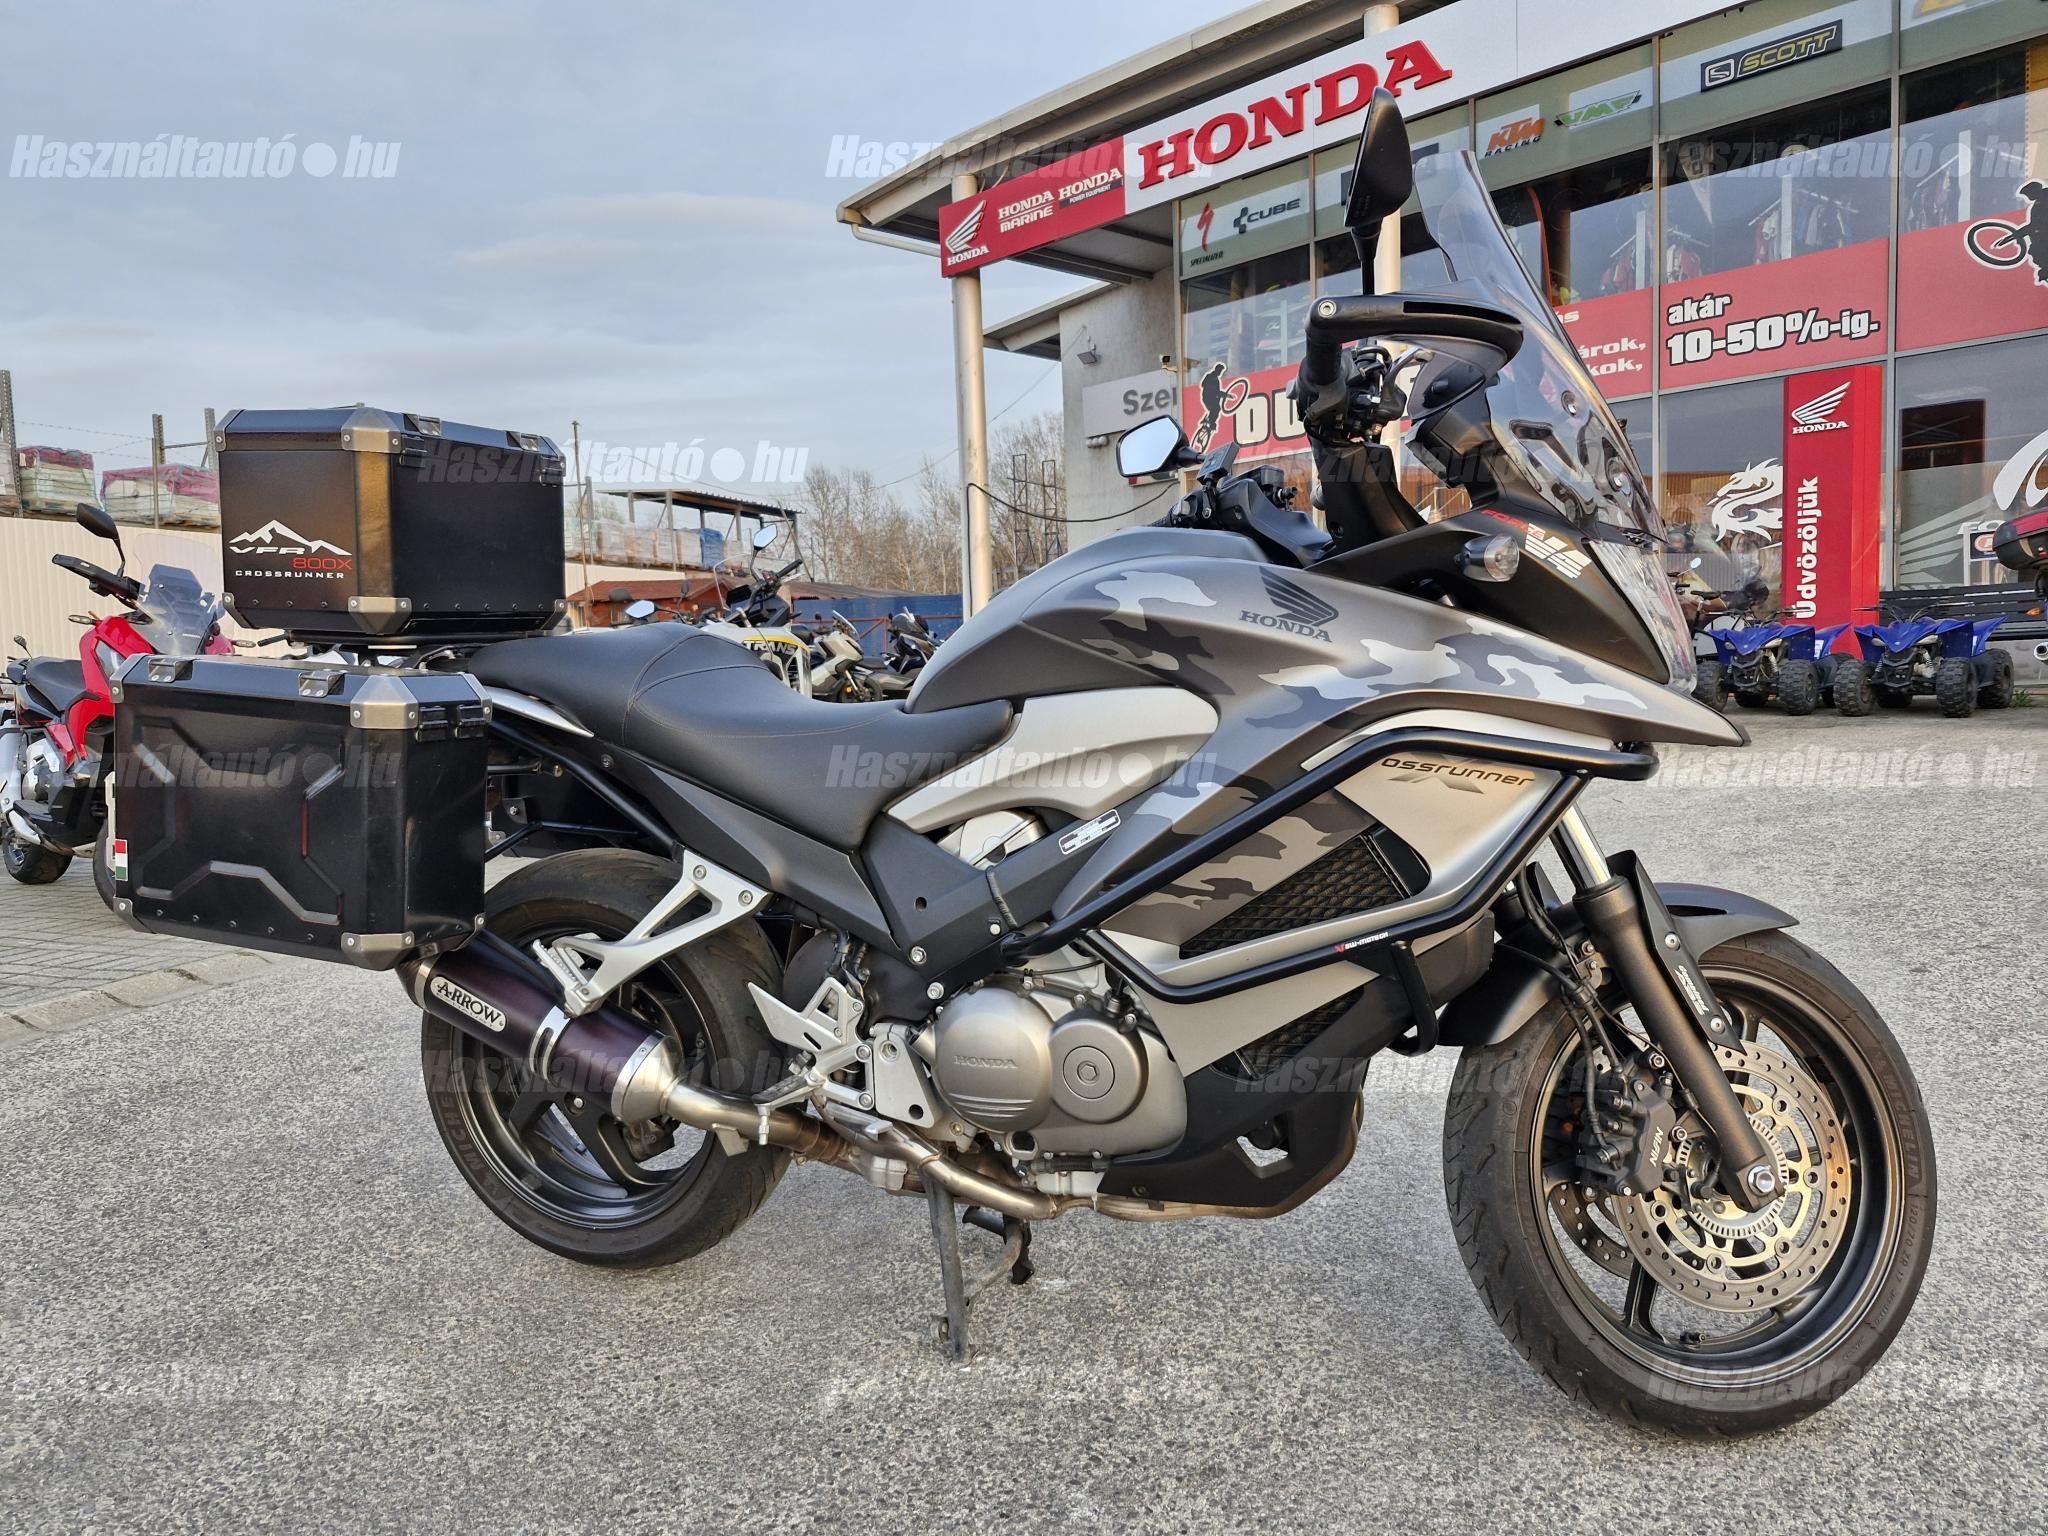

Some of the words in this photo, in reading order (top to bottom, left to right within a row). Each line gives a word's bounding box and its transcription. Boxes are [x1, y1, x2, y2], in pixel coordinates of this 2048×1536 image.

[1743, 31, 1831, 72] SCOTT
[1138, 39, 1453, 190] HONDA
[1485, 135, 1542, 158] RACING
[1487, 116, 1546, 151] KTM
[1058, 167, 1123, 201] HONDA
[998, 190, 1055, 220] HONDA
[1000, 204, 1054, 233] MARINE
[1246, 198, 1301, 223] CUBE
[946, 244, 990, 267] HONDA
[1668, 293, 1732, 325] akár
[1666, 308, 1880, 366] 10-50%-ig.
[1792, 420, 1849, 435] HONDA
[229, 546, 307, 555] VFR
[1791, 476, 1823, 619] Üdvözöljük
[235, 570, 345, 579] CROSSRUNNER
[292, 557, 353, 571] 800X
[1239, 610, 1333, 643] HONDA
[437, 981, 502, 1024] ARROW
[953, 1055, 1019, 1070] HONDA
